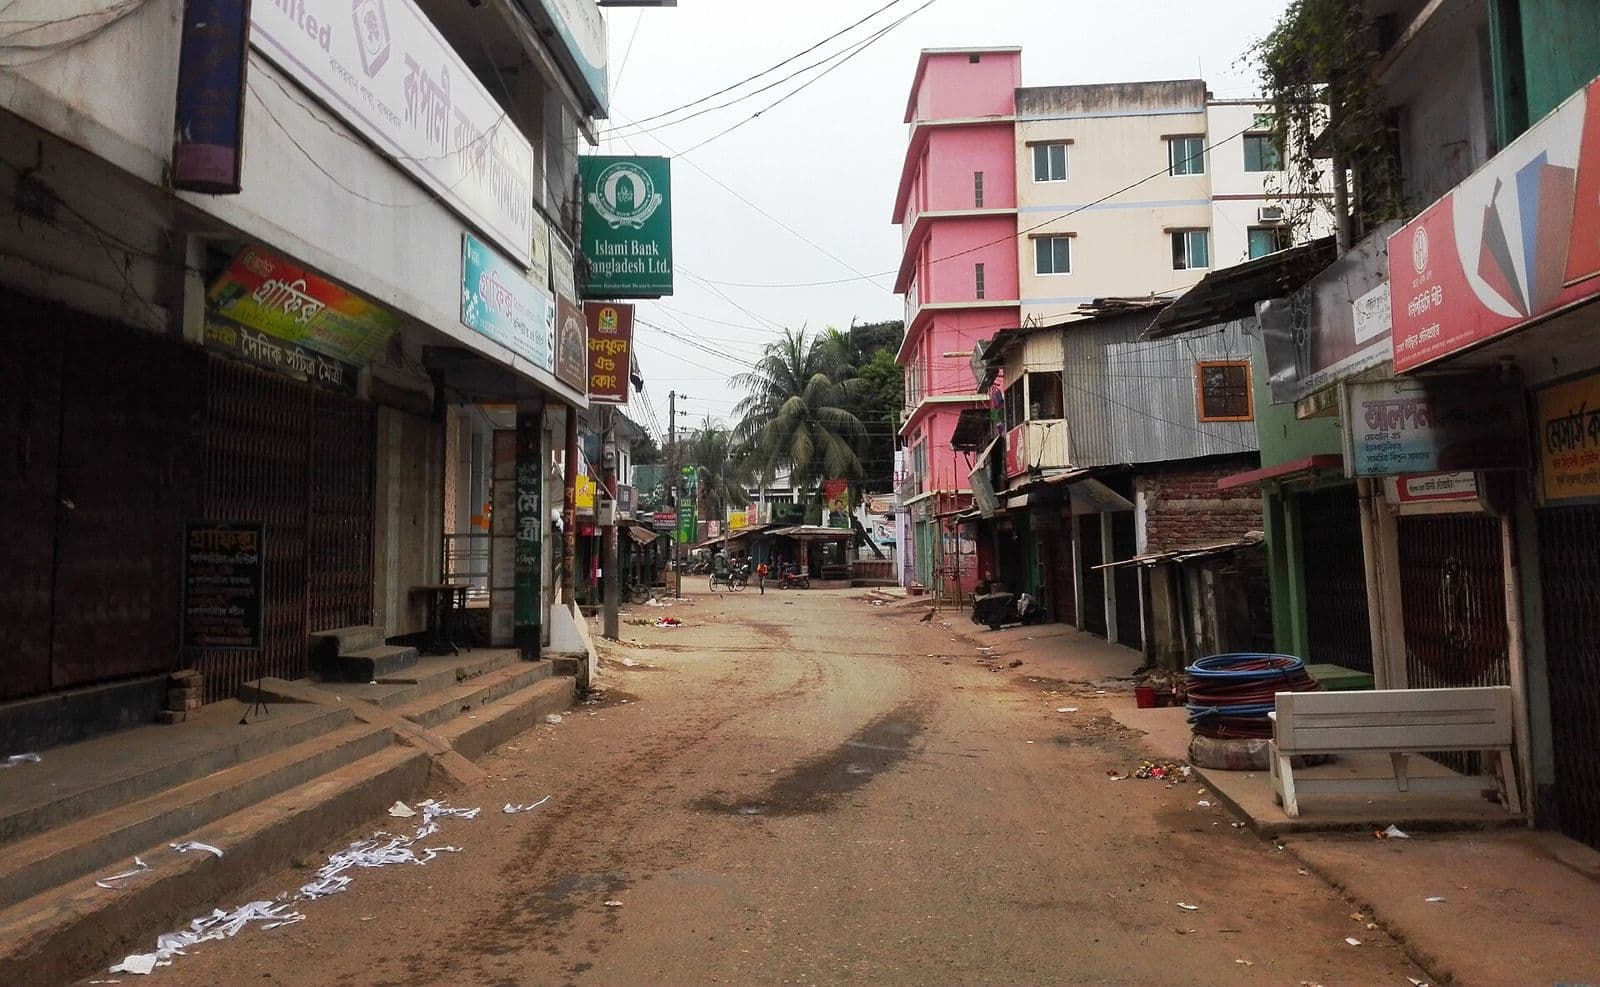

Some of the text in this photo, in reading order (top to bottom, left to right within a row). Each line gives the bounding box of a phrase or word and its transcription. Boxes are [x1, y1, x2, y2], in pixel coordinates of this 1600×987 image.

[595, 239, 659, 256] Islami Bank
[648, 257, 671, 274] Ltd.
[240, 325, 283, 366] দৈনিক
[587, 338, 628, 356] বনফুল
[590, 374, 617, 389] কোং
